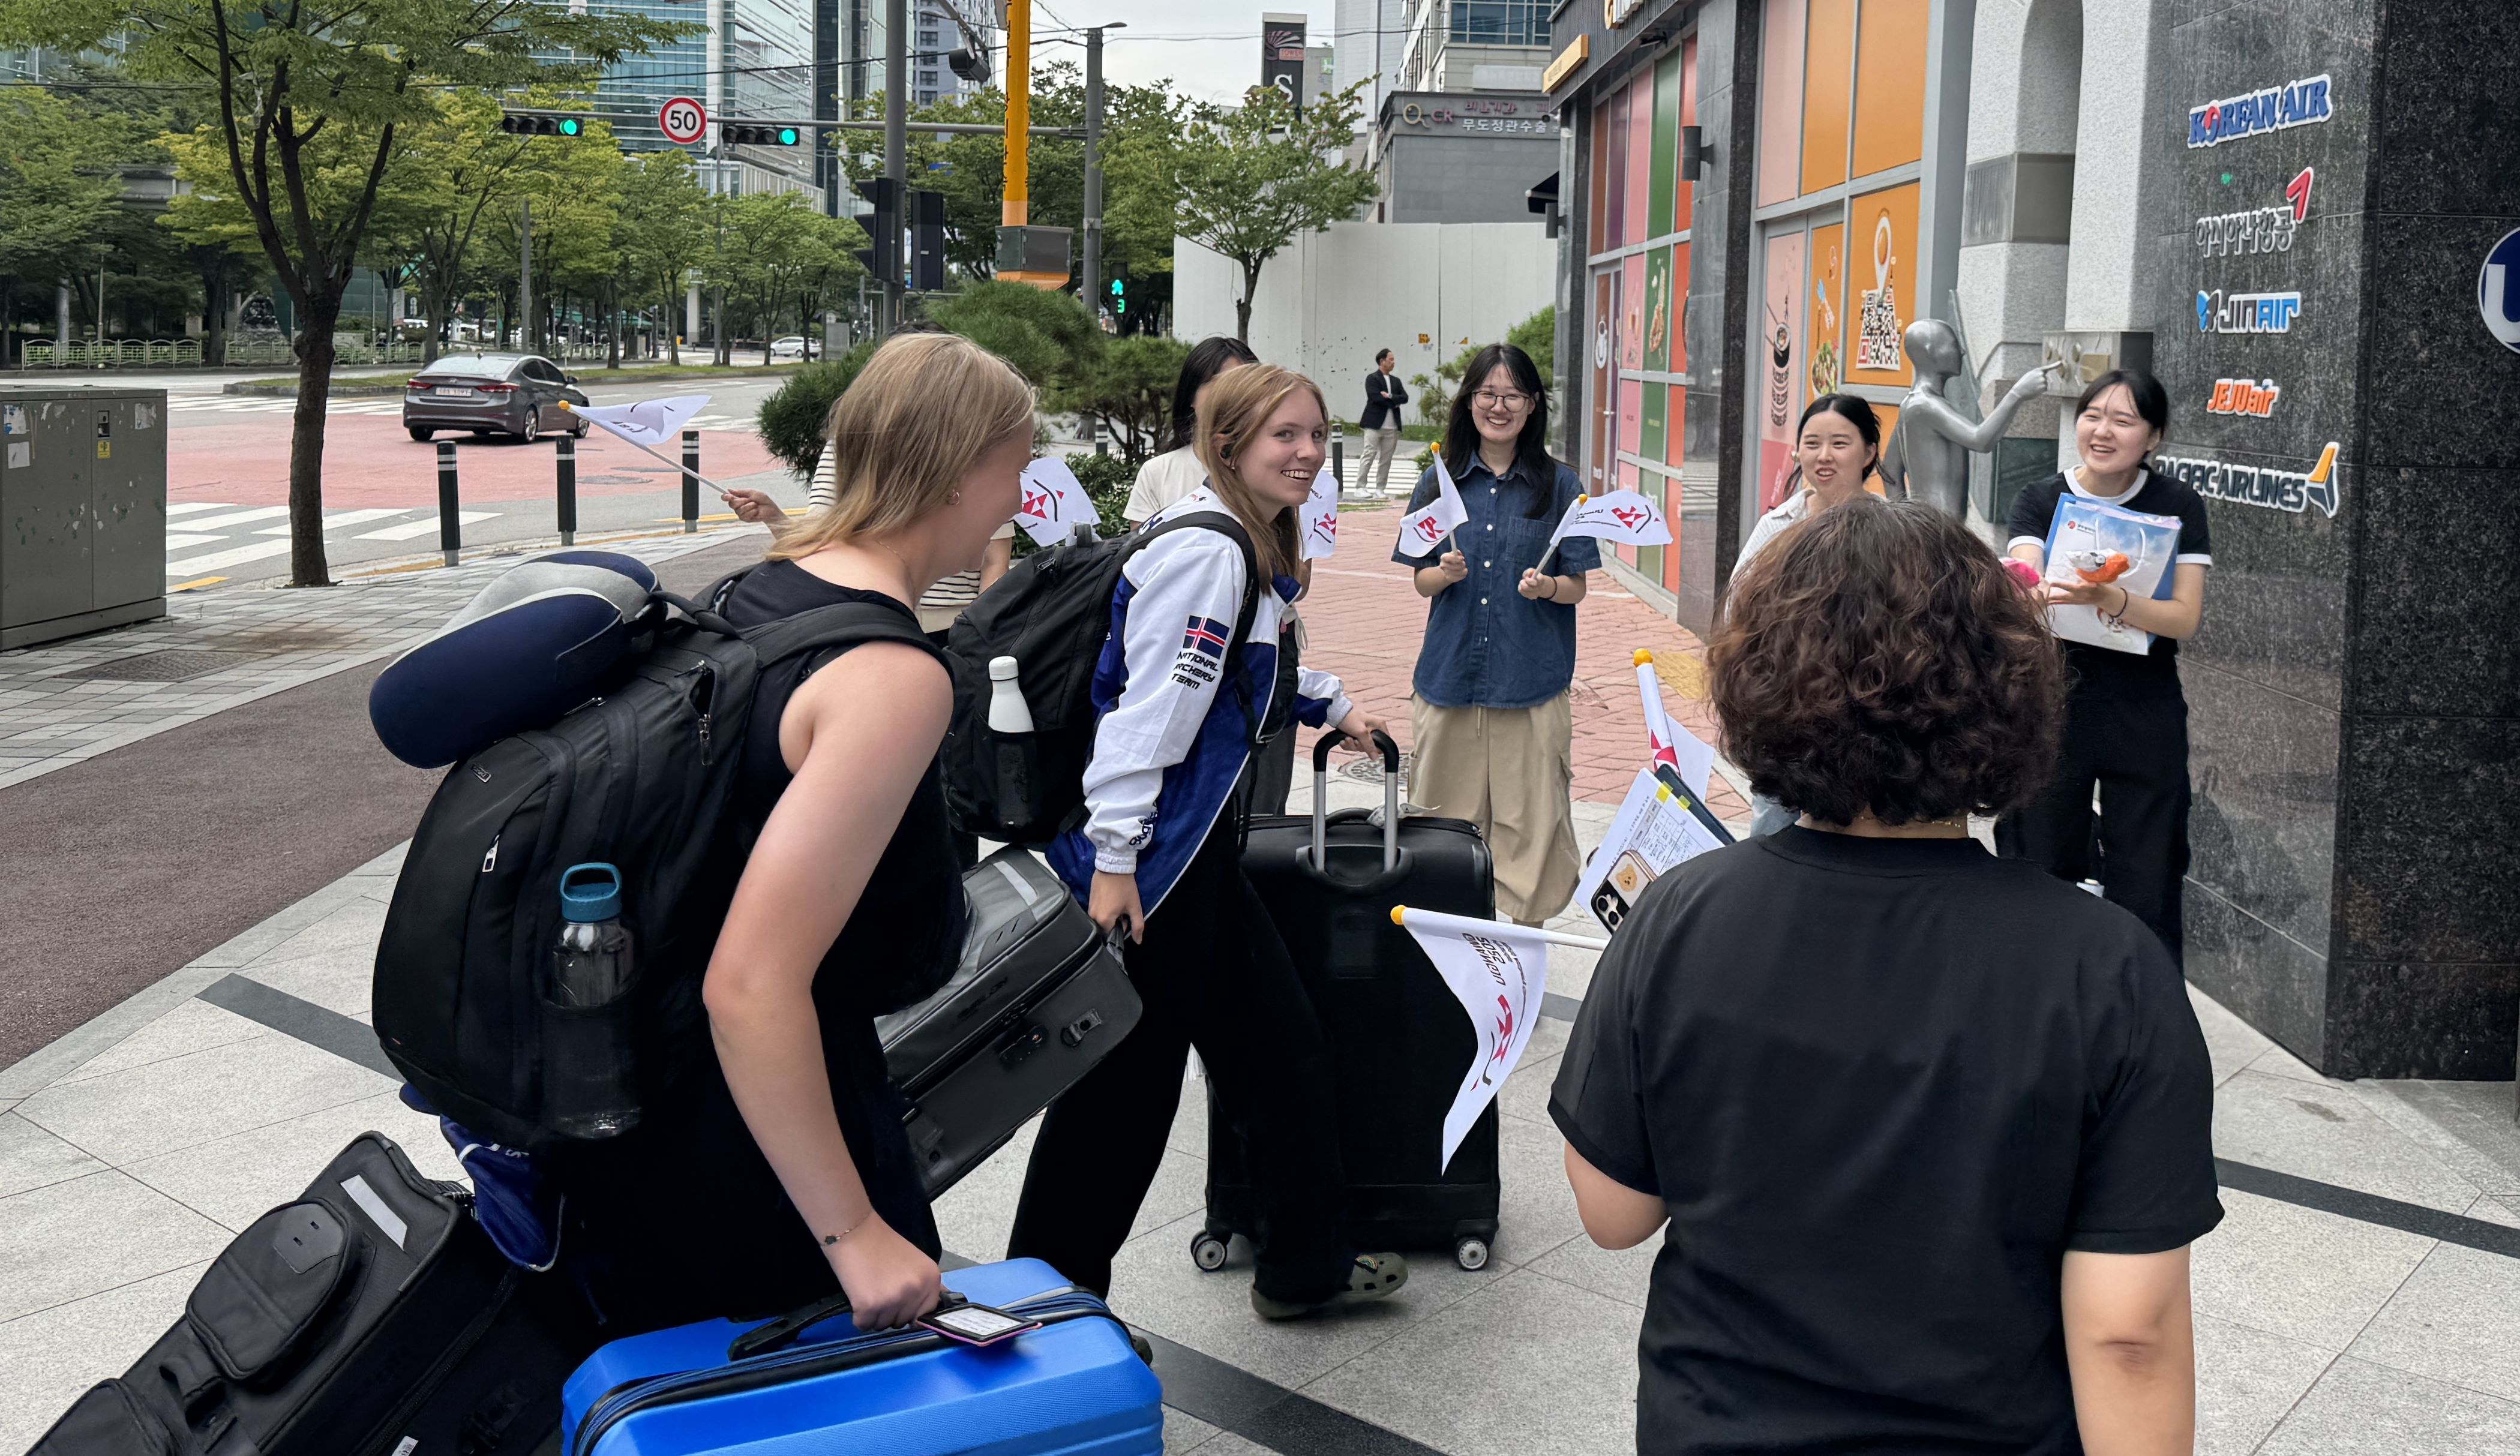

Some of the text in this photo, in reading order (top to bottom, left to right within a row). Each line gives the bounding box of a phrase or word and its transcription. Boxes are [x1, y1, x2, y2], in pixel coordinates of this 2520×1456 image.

[669, 109, 697, 131] 50
[2188, 80, 2329, 145] KOREAN AIR
[2196, 206, 2296, 257] 아시아나항공
[1177, 651, 1219, 671] NATIONAL
[1171, 673, 1201, 690] TEAM
[1173, 663, 1216, 683] ARCHERY
